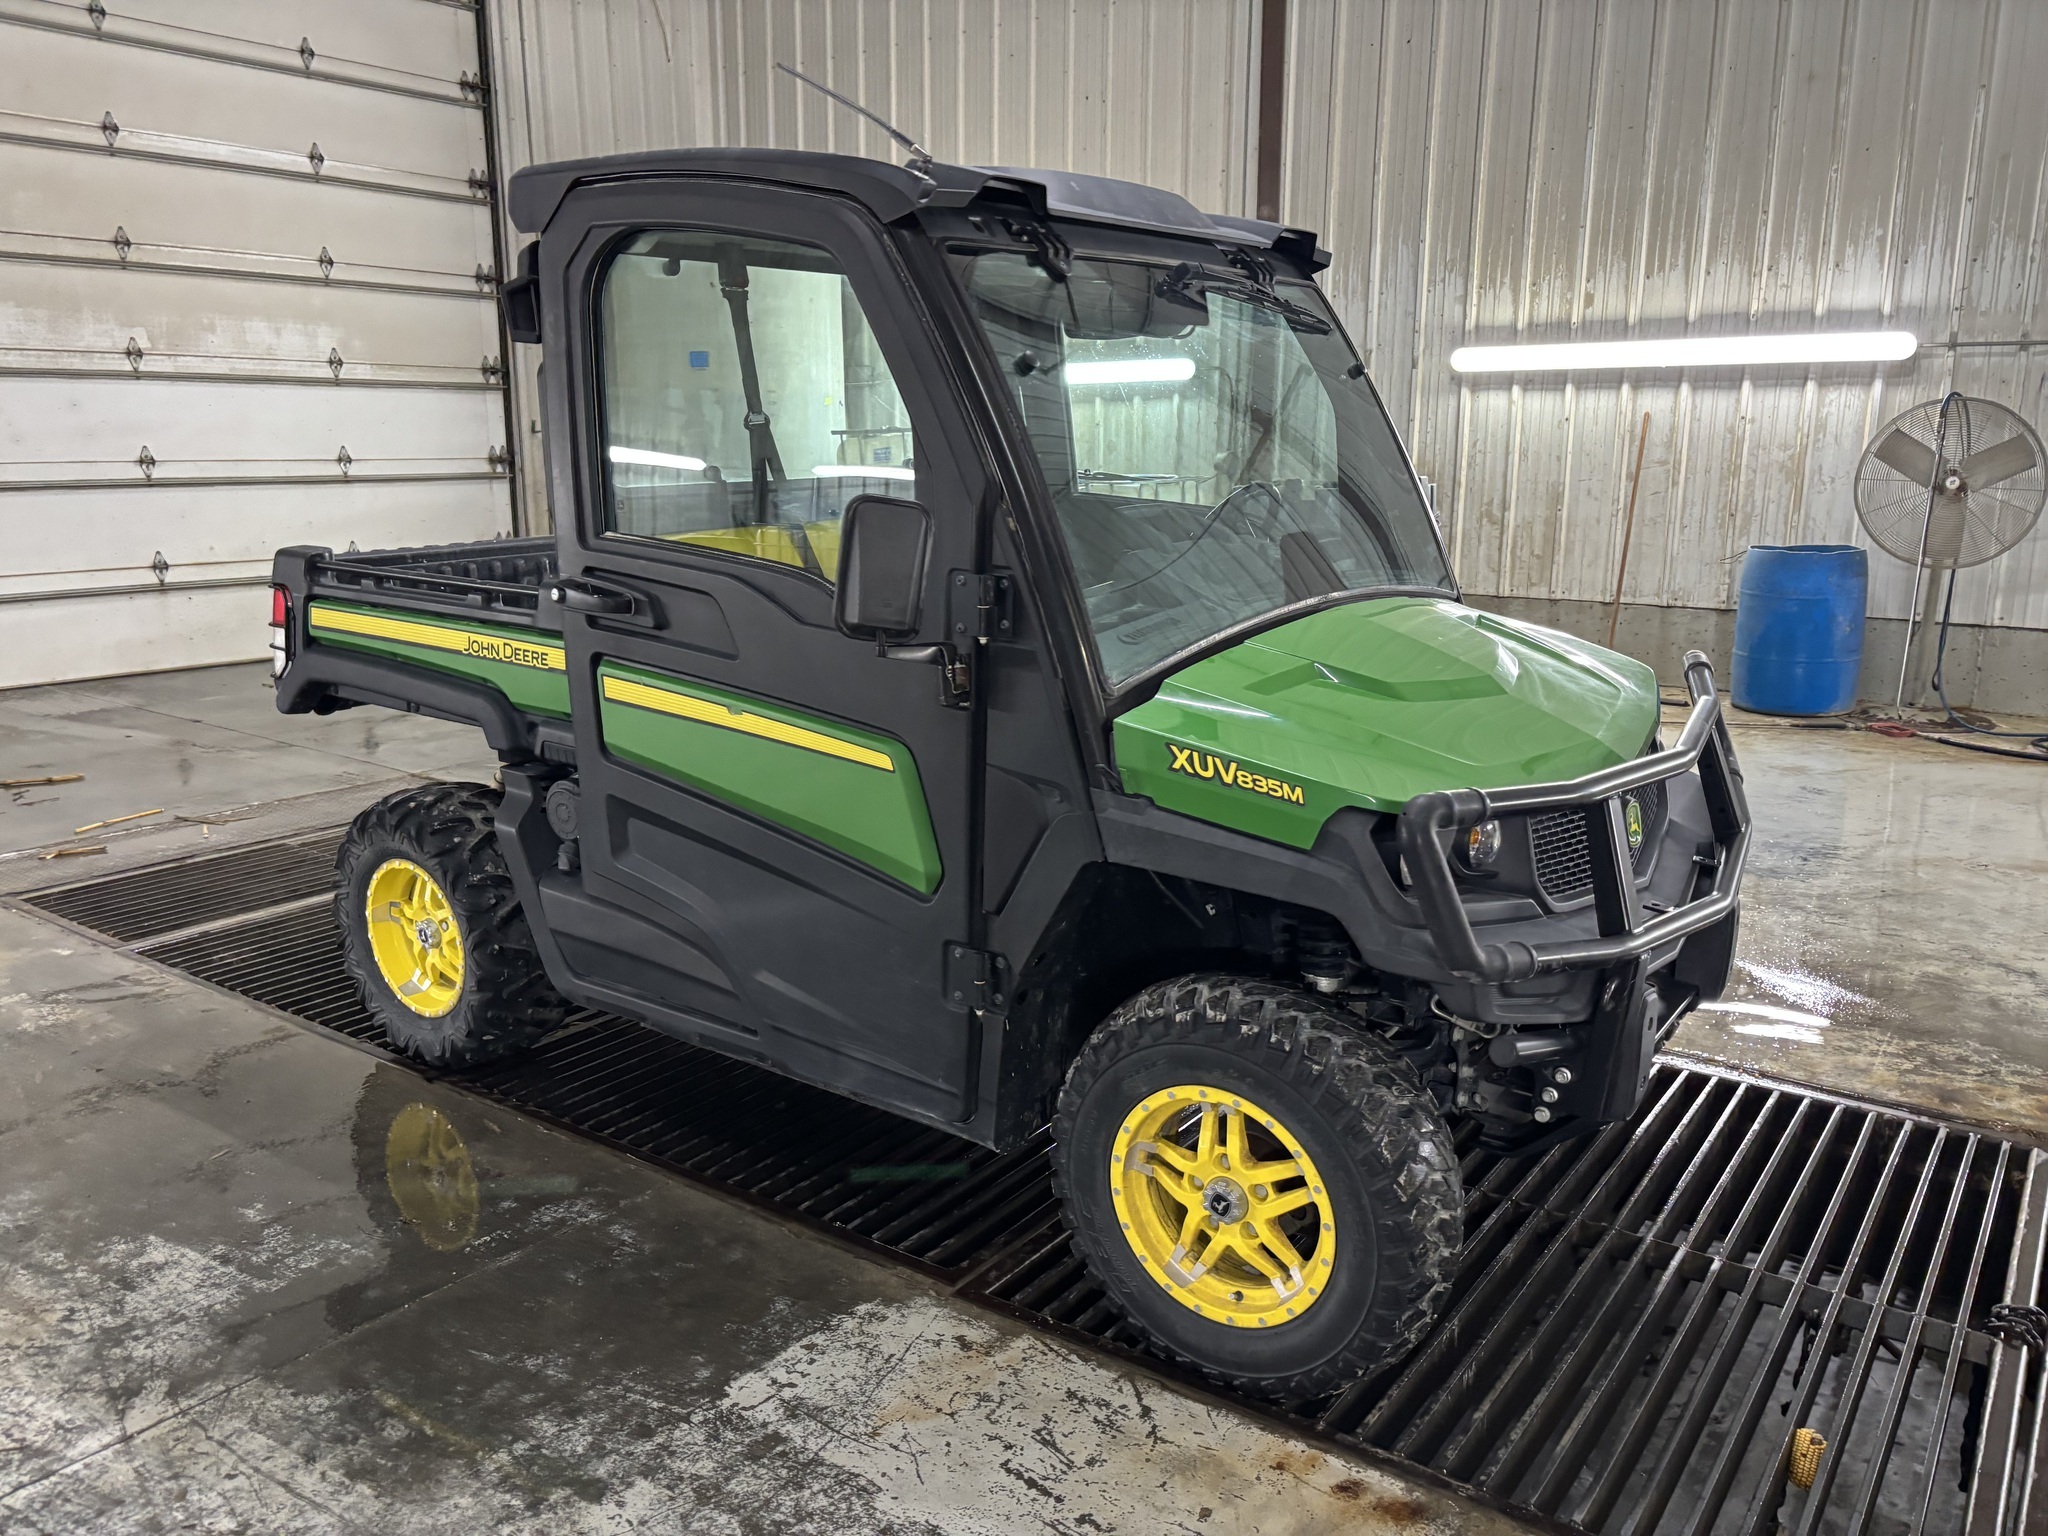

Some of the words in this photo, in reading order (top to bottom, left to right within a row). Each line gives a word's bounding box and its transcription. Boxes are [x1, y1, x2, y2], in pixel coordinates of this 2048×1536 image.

[463, 636, 500, 658] JOHN
[503, 641, 549, 667] DEERE
[1167, 743, 1305, 805] XUV835M
